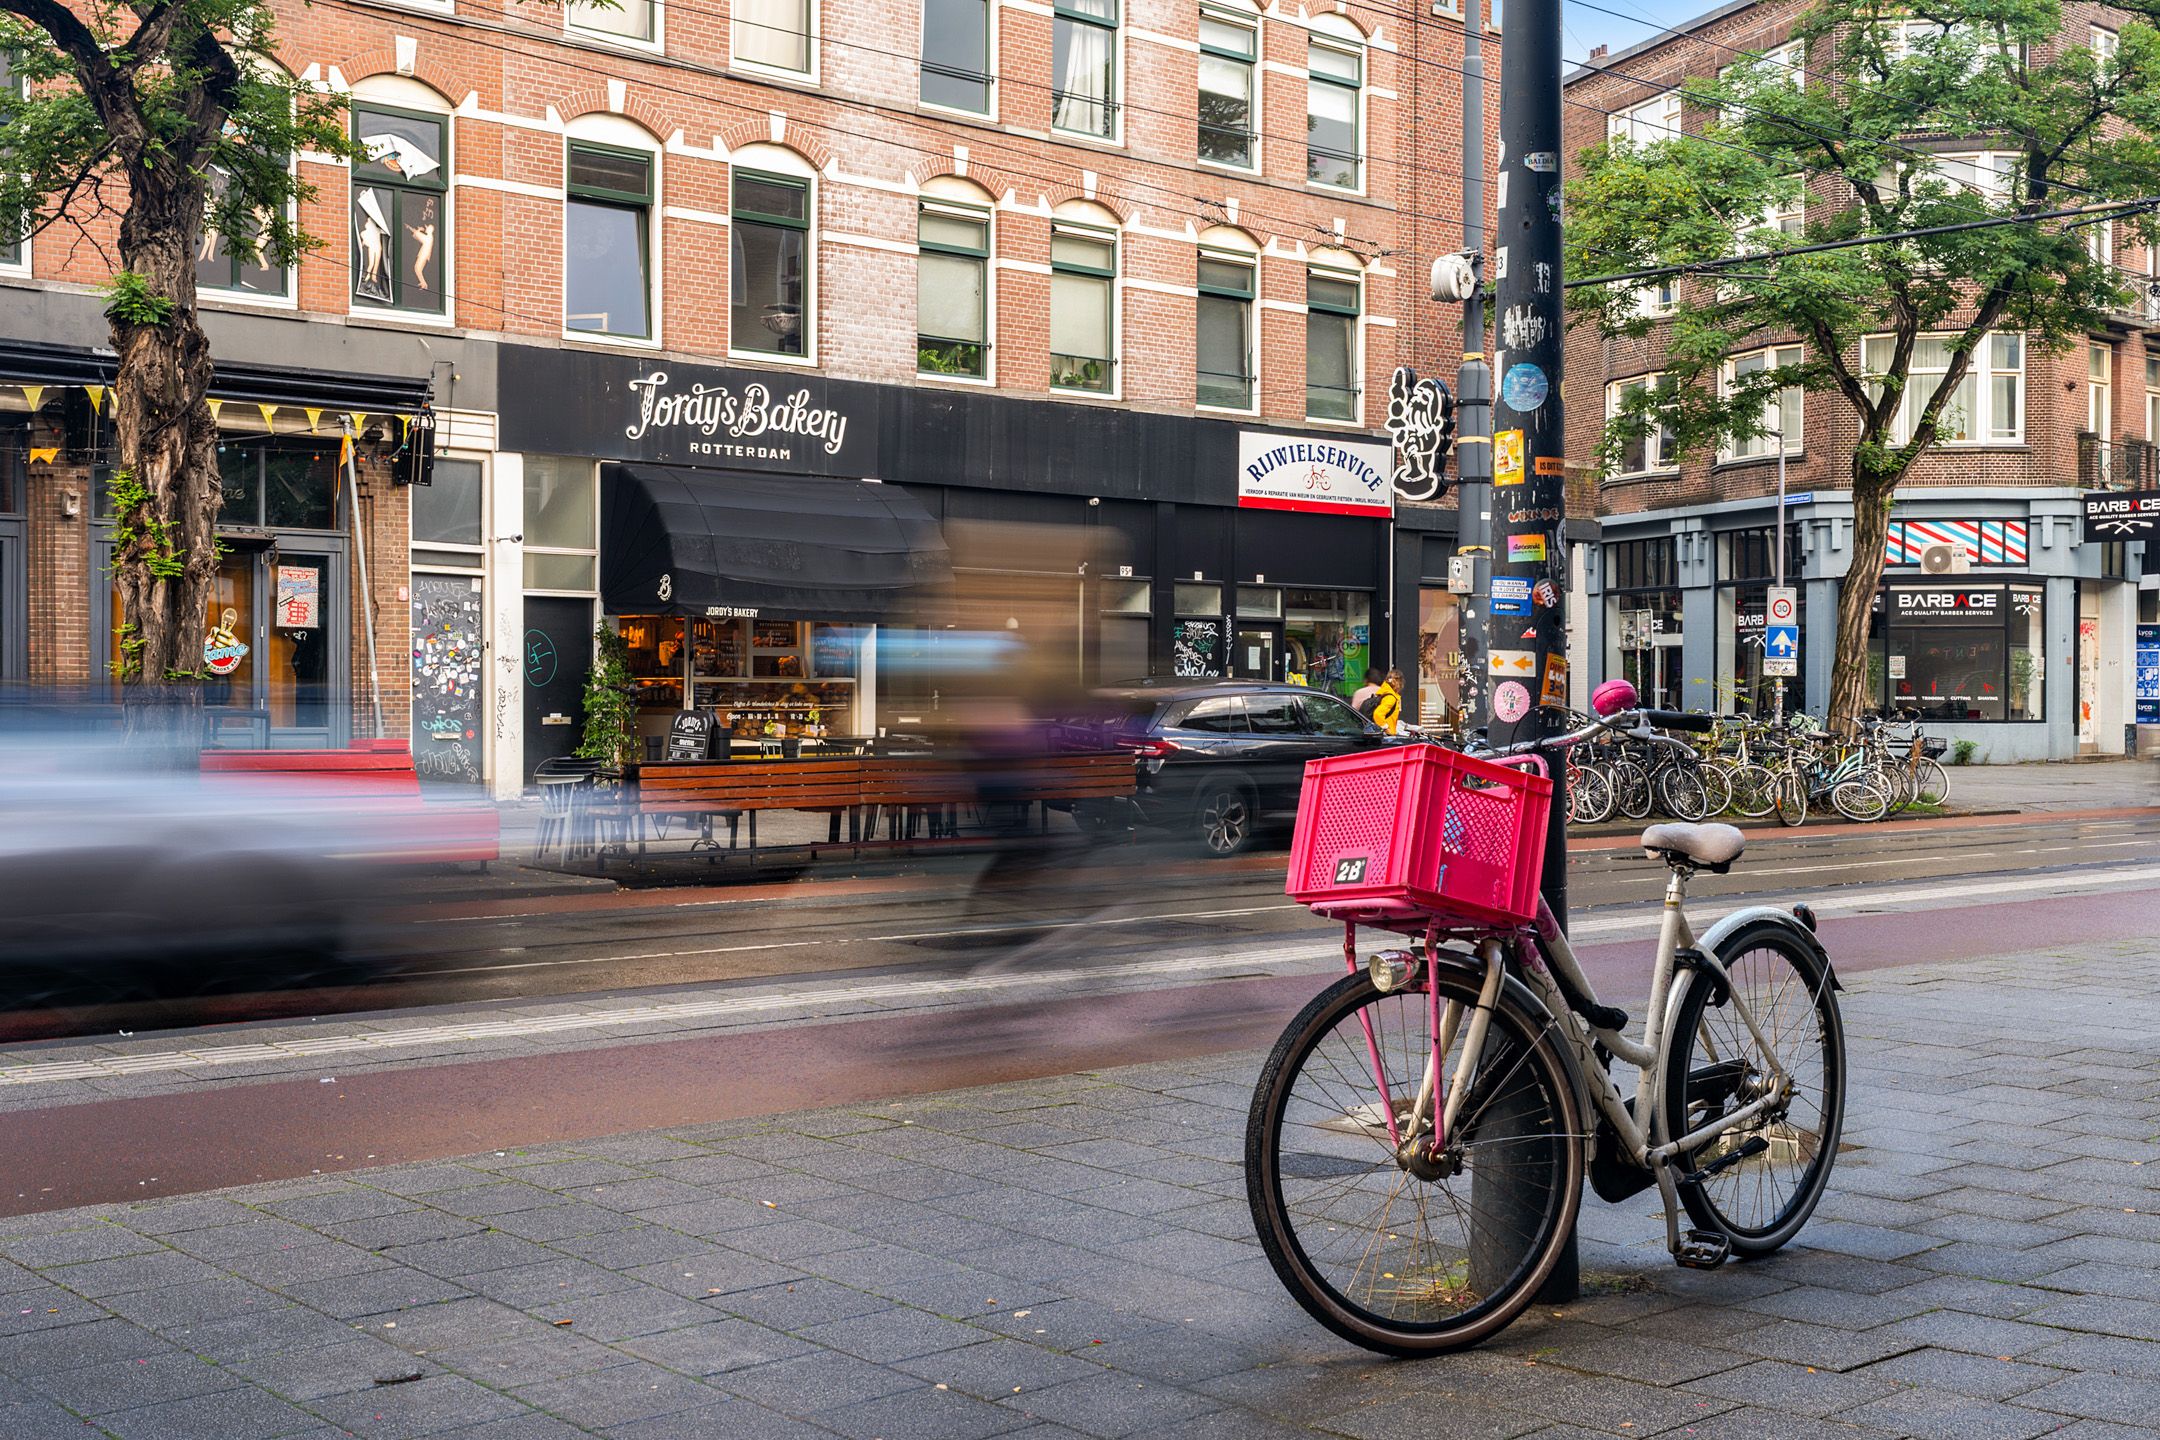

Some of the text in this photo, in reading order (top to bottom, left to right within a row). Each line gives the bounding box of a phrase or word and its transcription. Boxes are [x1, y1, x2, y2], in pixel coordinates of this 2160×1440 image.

[729, 383, 847, 455] Bakery
[690, 442, 791, 460] ROTTERDAM
[1246, 444, 1383, 492] RIJWIELSERVICE
[2087, 499, 2160, 514] BARBACE
[1539, 582, 1557, 608] IRIS
[1898, 594, 1997, 608] BARBACE
[2013, 594, 2041, 604] BARBACE
[706, 606, 759, 618] JORDY'S BAKERY
[1776, 604, 1788, 613] 30
[1738, 614, 1767, 627] BARB
[1336, 860, 1362, 881] 2B
